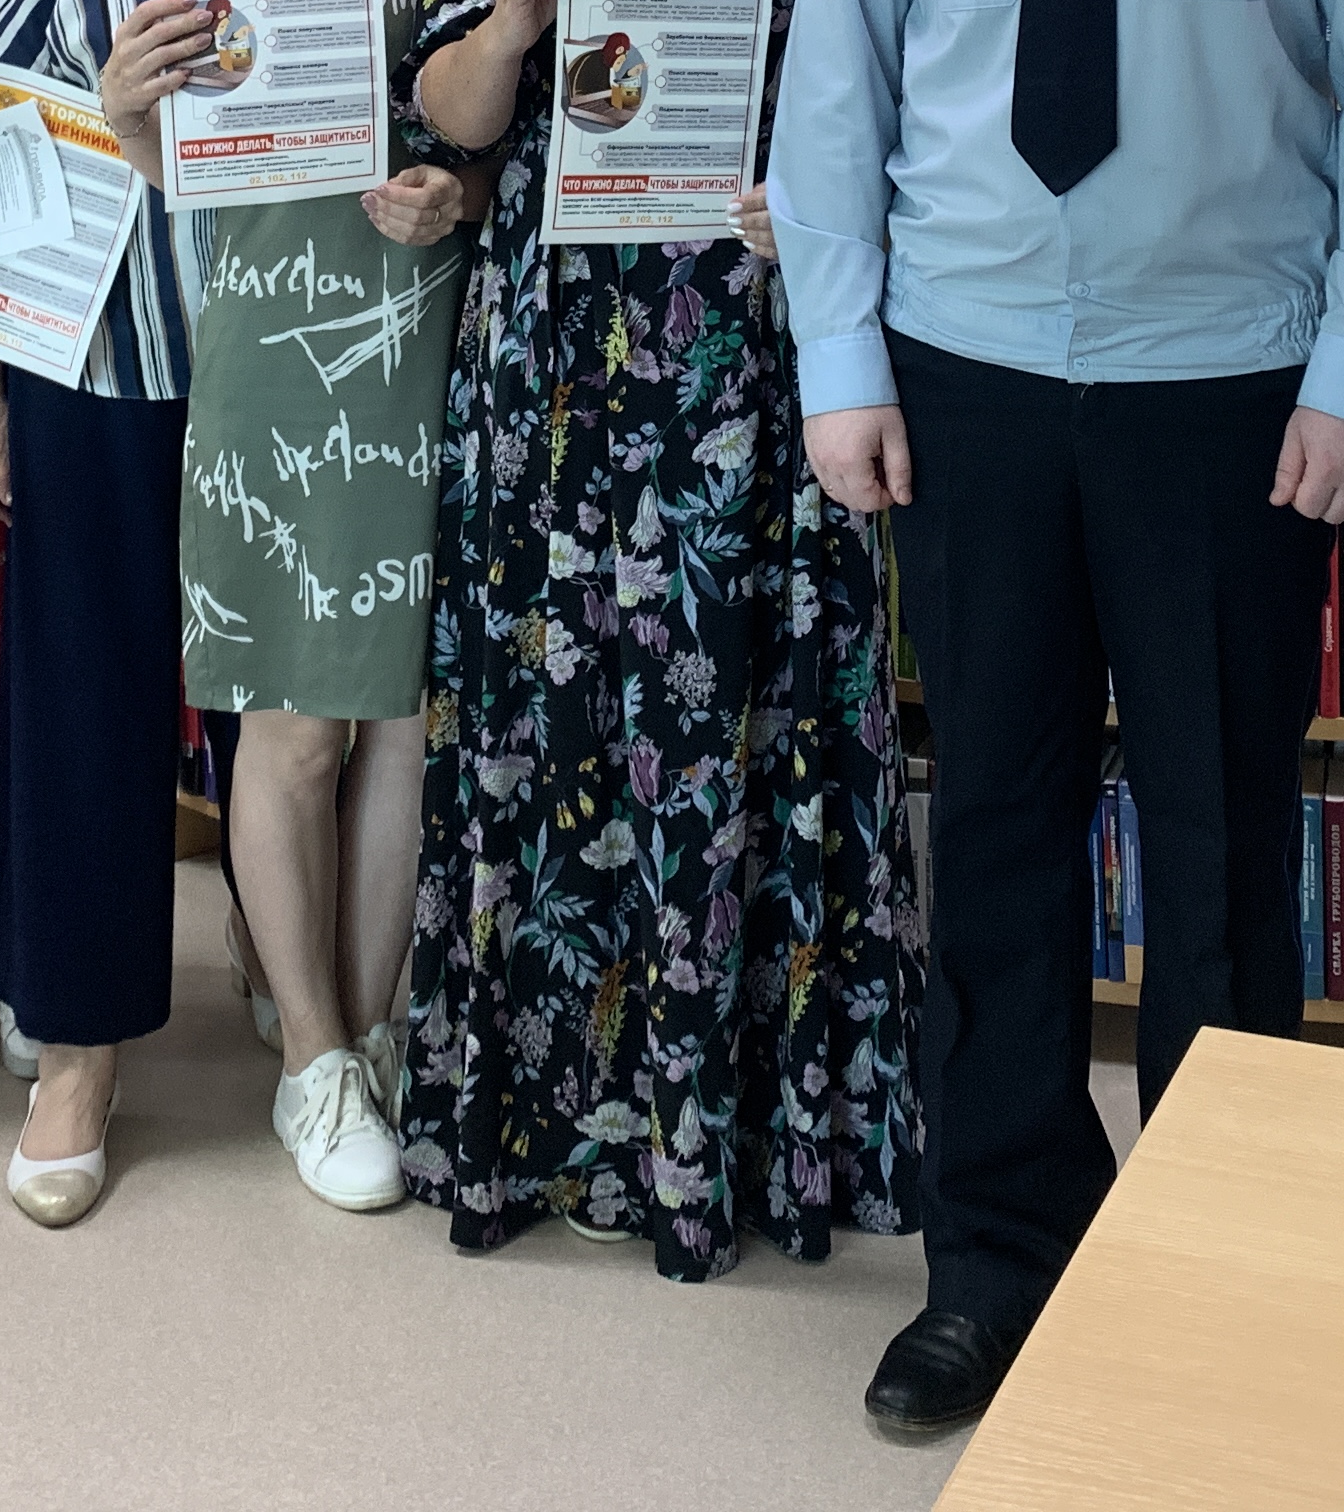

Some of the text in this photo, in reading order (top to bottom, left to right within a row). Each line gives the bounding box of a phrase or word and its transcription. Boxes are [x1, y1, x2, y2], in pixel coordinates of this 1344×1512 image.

[31, 97, 116, 138] СТОРОЖН
[42, 115, 121, 154] ШЕННИКИ
[182, 145, 200, 156] ЧТО
[202, 142, 234, 154] НУЖНО
[276, 135, 307, 147] ЧТОБЫ
[309, 129, 367, 146] ЗАЩИТИТЬСЯ
[563, 179, 581, 191] ЧТО
[582, 179, 612, 190] НУЖНО
[650, 178, 678, 189] ЧТОБЫ
[681, 177, 735, 191] ЗАЩИТИТЬСЯ
[8, 301, 31, 317] ЧТОБЫ
[32, 310, 76, 333] ЗАЩИТИТЬСЯ
